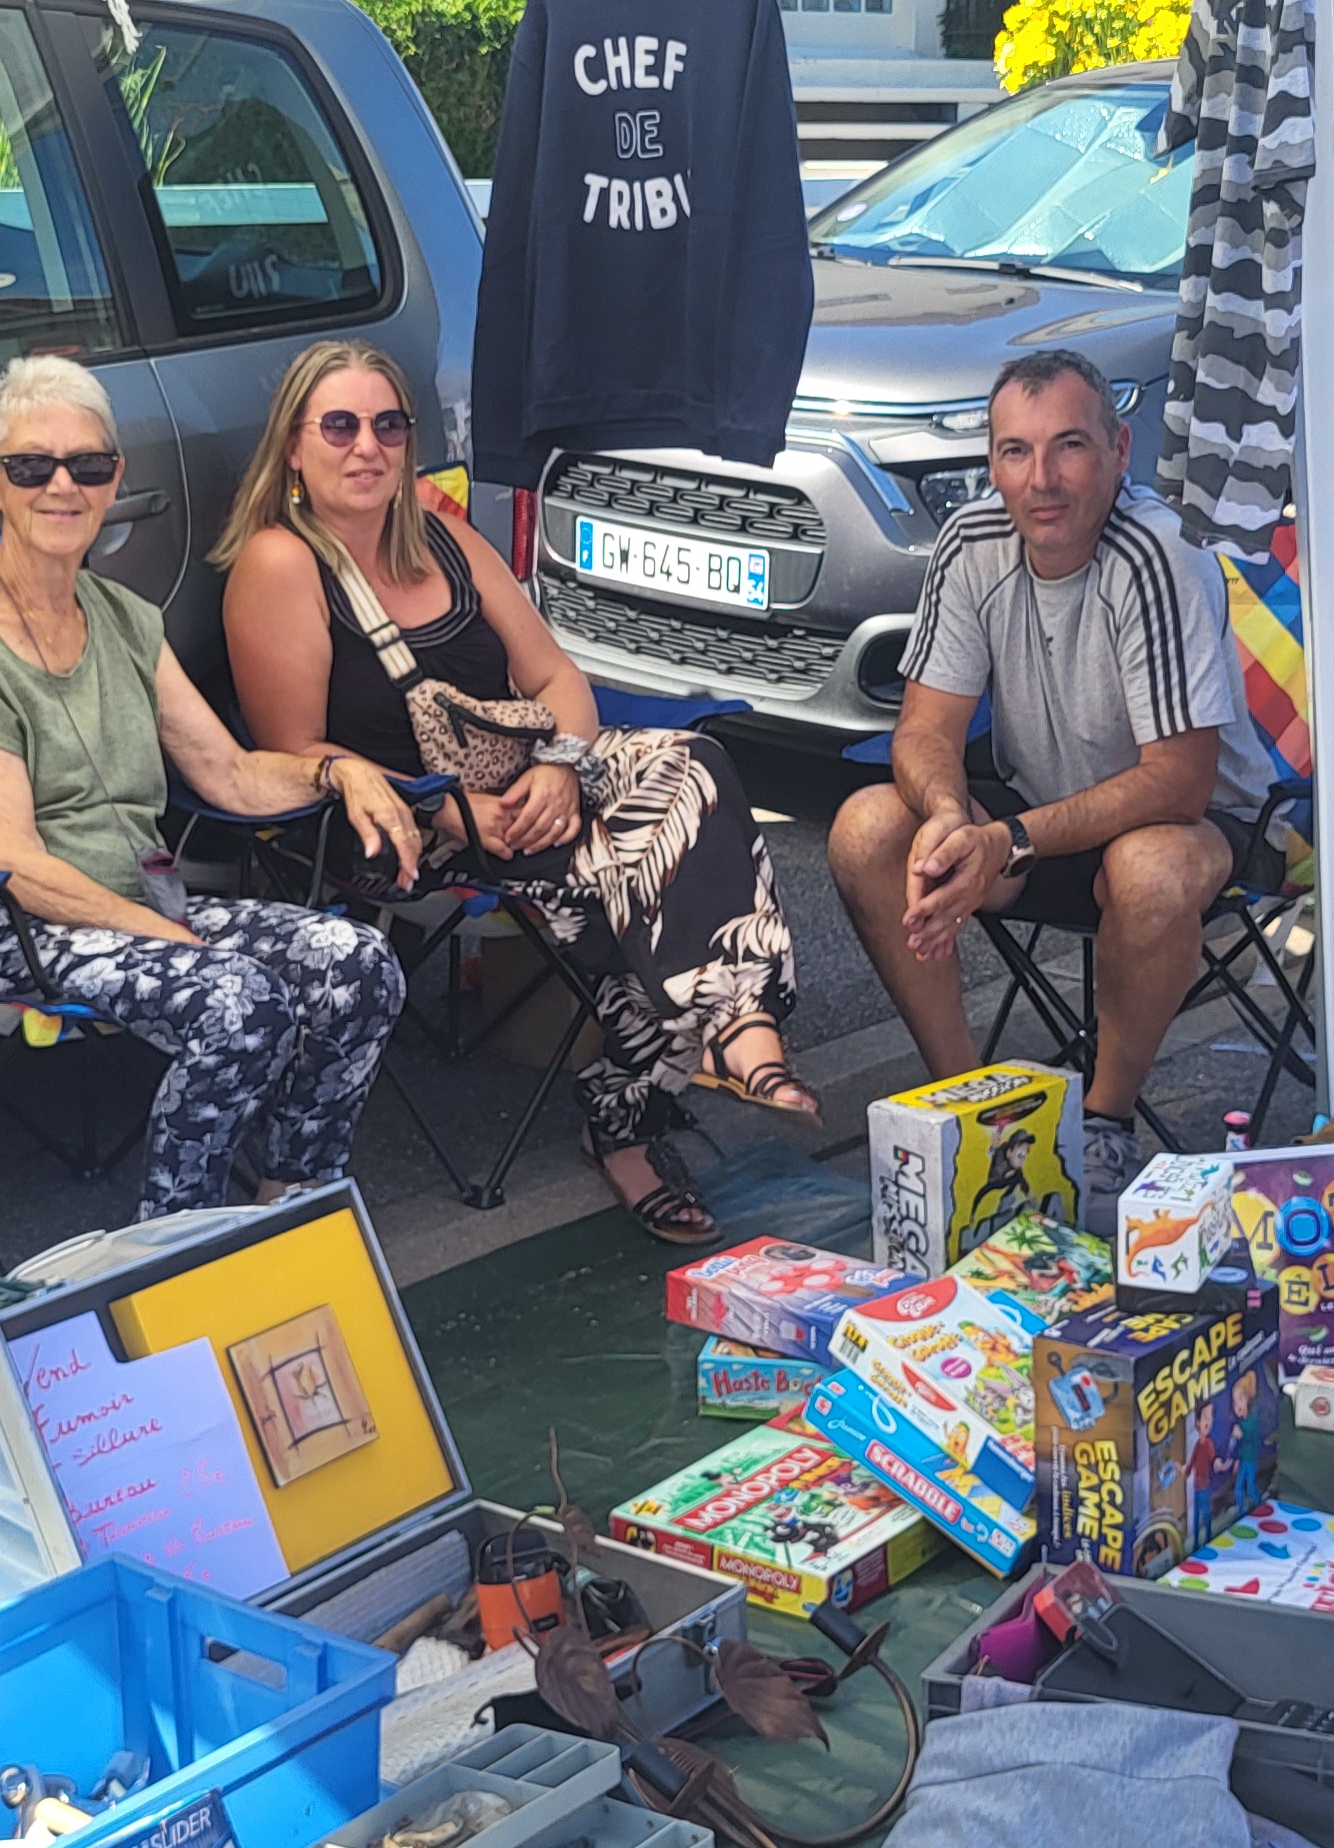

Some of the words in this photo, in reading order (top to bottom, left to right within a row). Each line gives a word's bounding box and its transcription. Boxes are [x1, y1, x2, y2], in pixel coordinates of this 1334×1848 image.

[573, 35, 688, 96] CHEF
[614, 109, 664, 159] DE
[894, 1146, 929, 1281] MEGA
[775, 1369, 822, 1397] Boc
[1137, 1312, 1244, 1422] ESCAPE
[1147, 1357, 1228, 1444] GAME
[683, 1446, 822, 1529] MONOPOLY
[870, 1442, 961, 1523] SCRABBLE
[1074, 1440, 1100, 1542] GAME
[1094, 1440, 1125, 1572] ESCAPE
[719, 1555, 799, 1592] MONOPOLY
[132, 1806, 212, 1848] SLIDER
